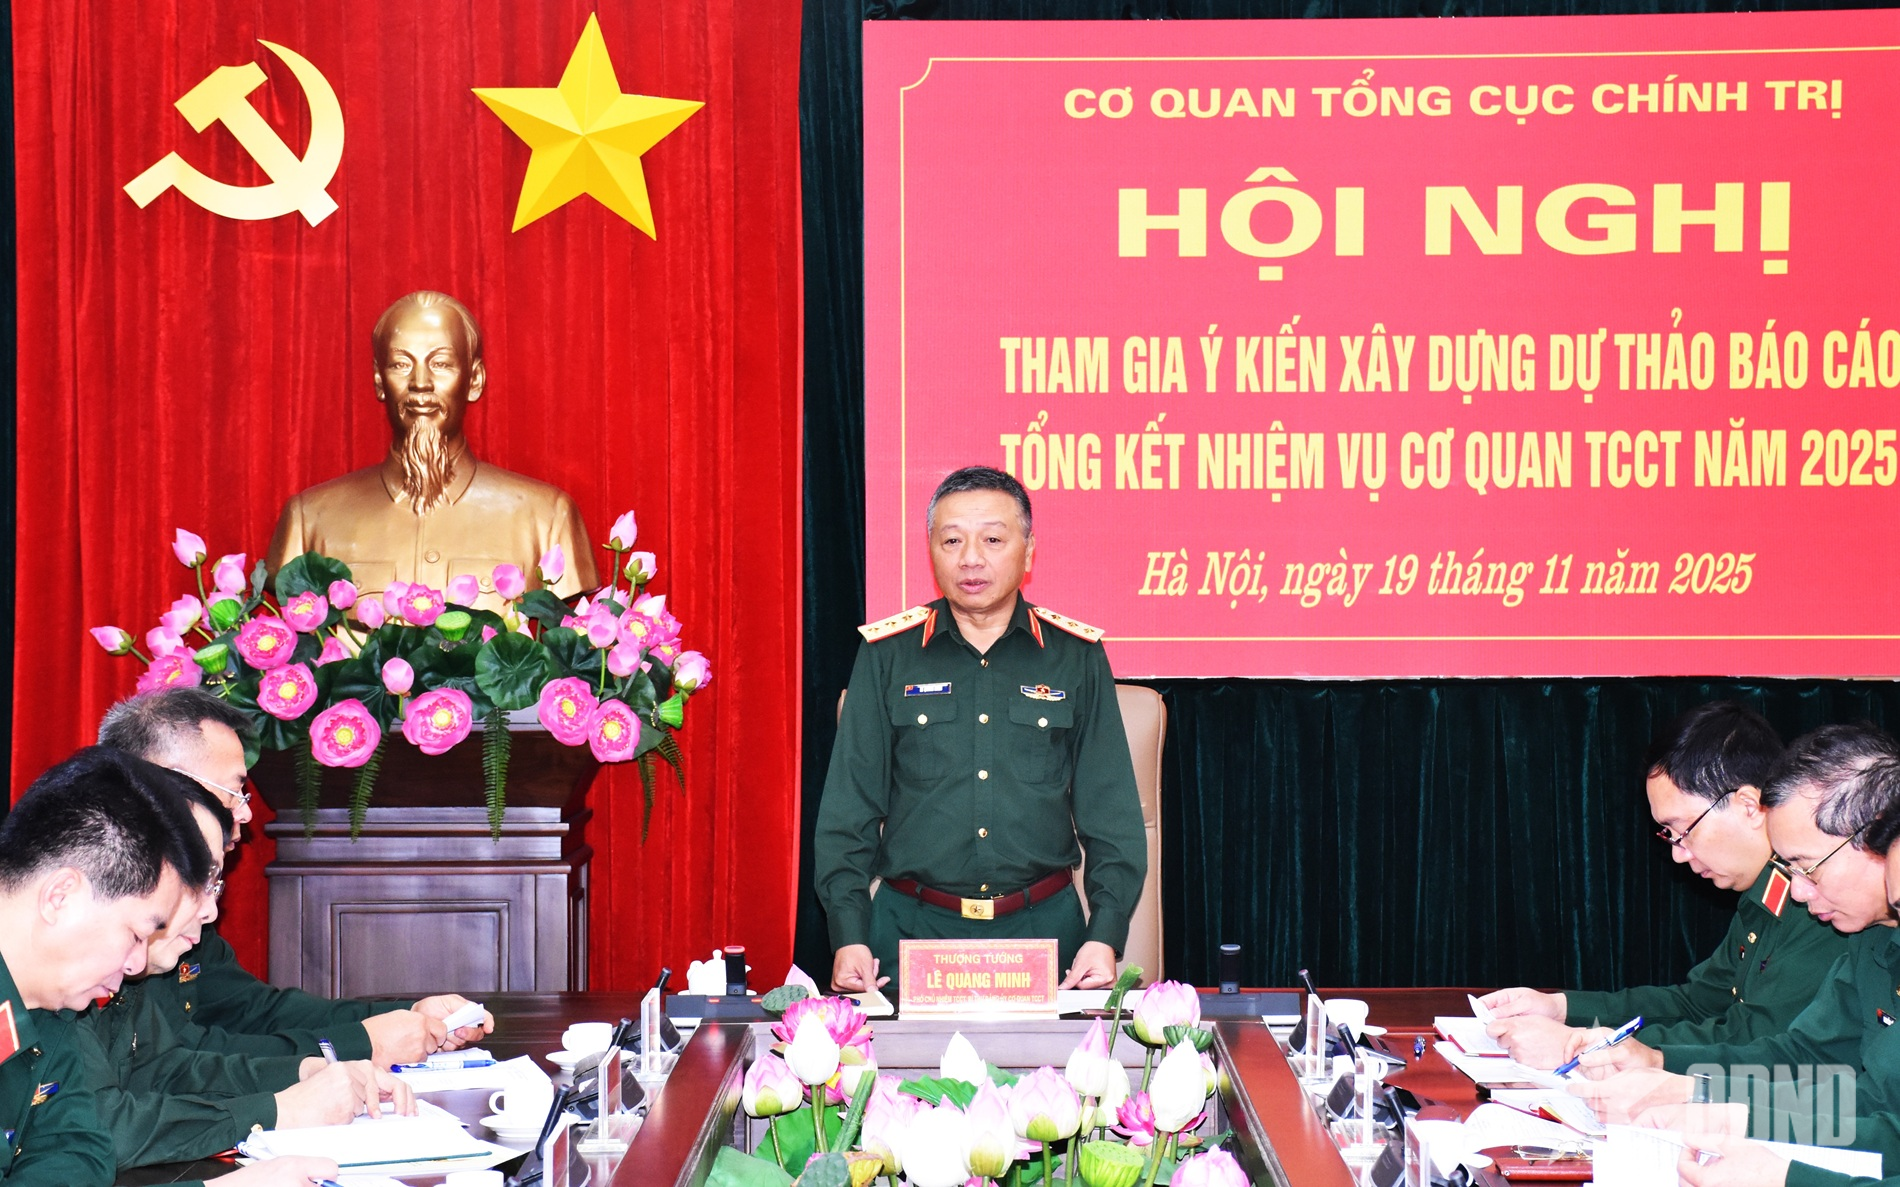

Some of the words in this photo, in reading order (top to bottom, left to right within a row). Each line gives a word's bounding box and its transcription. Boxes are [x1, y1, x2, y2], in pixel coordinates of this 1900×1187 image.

[1064, 86, 1133, 118] CƠ
[1150, 88, 1295, 118] QUAN
[1312, 68, 1451, 117] TỔNG
[1470, 84, 1574, 125] CỤC
[1592, 74, 1747, 114] CHÍNH
[1765, 80, 1842, 118] TRỊ
[1118, 167, 1364, 281] HỘI
[1425, 182, 1790, 274] NGHỊ
[1000, 337, 1109, 393] THAM
[1123, 336, 1188, 394] GIA
[1200, 324, 1223, 393] Ý
[1236, 315, 1326, 392] KIẾN
[1339, 323, 1416, 392] XÂY
[1429, 329, 1535, 404] DỰNG
[1550, 328, 1607, 403] DỰ
[1614, 308, 1714, 390] THẢO
[1730, 319, 1808, 389] BÁO
[1823, 318, 1900, 388] CÁO
[1000, 410, 1101, 490] TỔNG
[1115, 412, 1185, 490] KẾT
[1198, 420, 1324, 502] NHIỆM
[1337, 432, 1386, 502] VỤ
[1400, 428, 1454, 489] CƠ
[1465, 431, 1572, 495] QUAN
[1585, 430, 1681, 488] TCCT
[1695, 418, 1786, 486] NĂM
[1801, 429, 1897, 486] 2025
[1138, 548, 1188, 596] Hà
[1197, 548, 1268, 609] Nội,
[1280, 547, 1374, 608] ngày
[1378, 554, 1419, 595] 19
[1428, 547, 1534, 607] tháng
[1539, 554, 1573, 594] 11
[1580, 548, 1659, 594] năm
[1668, 553, 1756, 594] 2025
[926, 969, 942, 989] LÊ
[946, 972, 991, 990] QUANG
[994, 972, 1030, 988] MINH
[933, 953, 980, 965] THƯỢNG
[984, 951, 1023, 964] TƯỚNG
